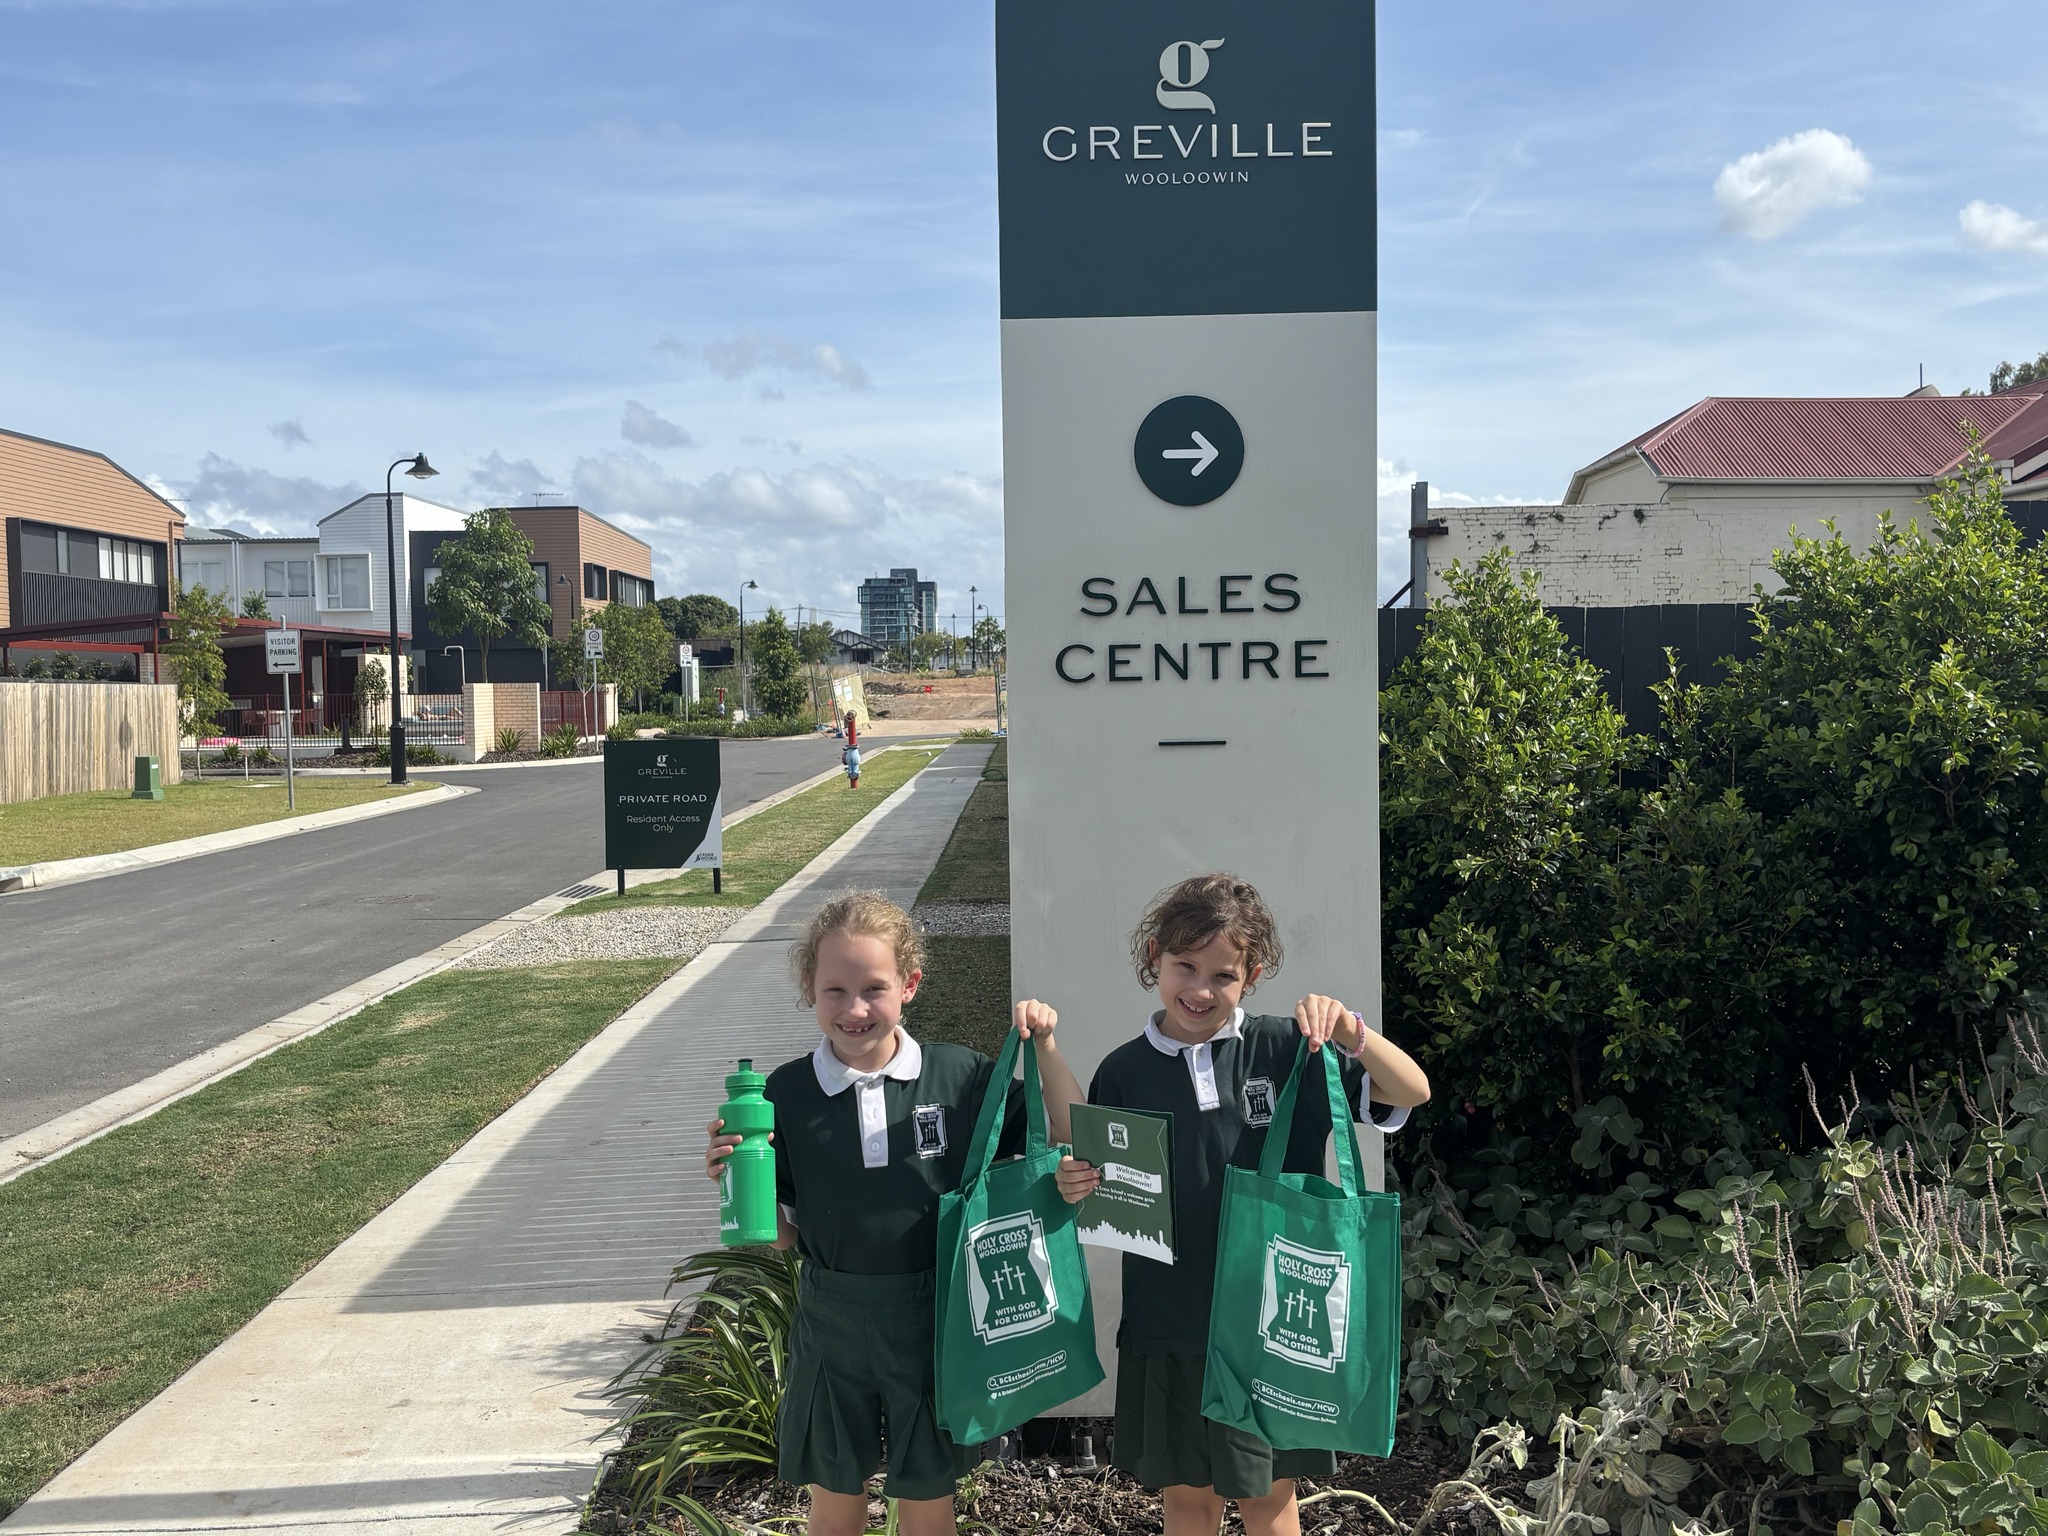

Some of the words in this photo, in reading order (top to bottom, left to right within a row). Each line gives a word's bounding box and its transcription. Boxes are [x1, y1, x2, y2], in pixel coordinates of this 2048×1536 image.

[1042, 122, 1333, 162] GREVILLE
[1125, 171, 1249, 185] WOOLOOWIN
[1080, 573, 1301, 617] SALES
[270, 637, 296, 645] VISITOR
[1055, 640, 1330, 683] CENTRE
[619, 795, 669, 803] PRIVATE
[673, 794, 707, 803] ROAD
[626, 815, 666, 823] Resident
[669, 815, 700, 823] Access
[653, 824, 674, 833] Only
[1116, 1165, 1143, 1179] Welcome
[977, 1236, 996, 1253] HOLY
[998, 1229, 1028, 1246] CROSS
[978, 1241, 1028, 1259] WOOLOOWIN
[1278, 1254, 1301, 1270] HOLY
[1302, 1263, 1333, 1280] CROSS
[1279, 1266, 1330, 1287] WOOLOOWIN
[995, 1315, 1011, 1326] FOR
[1012, 1308, 1041, 1321] OTHERS
[996, 1304, 1016, 1317] WITH
[1018, 1301, 1036, 1312] GOD
[1279, 1326, 1297, 1340] WITH
[1300, 1333, 1318, 1345] GOD
[1276, 1335, 1289, 1346] FOR
[1290, 1340, 1321, 1355] OTHERS
